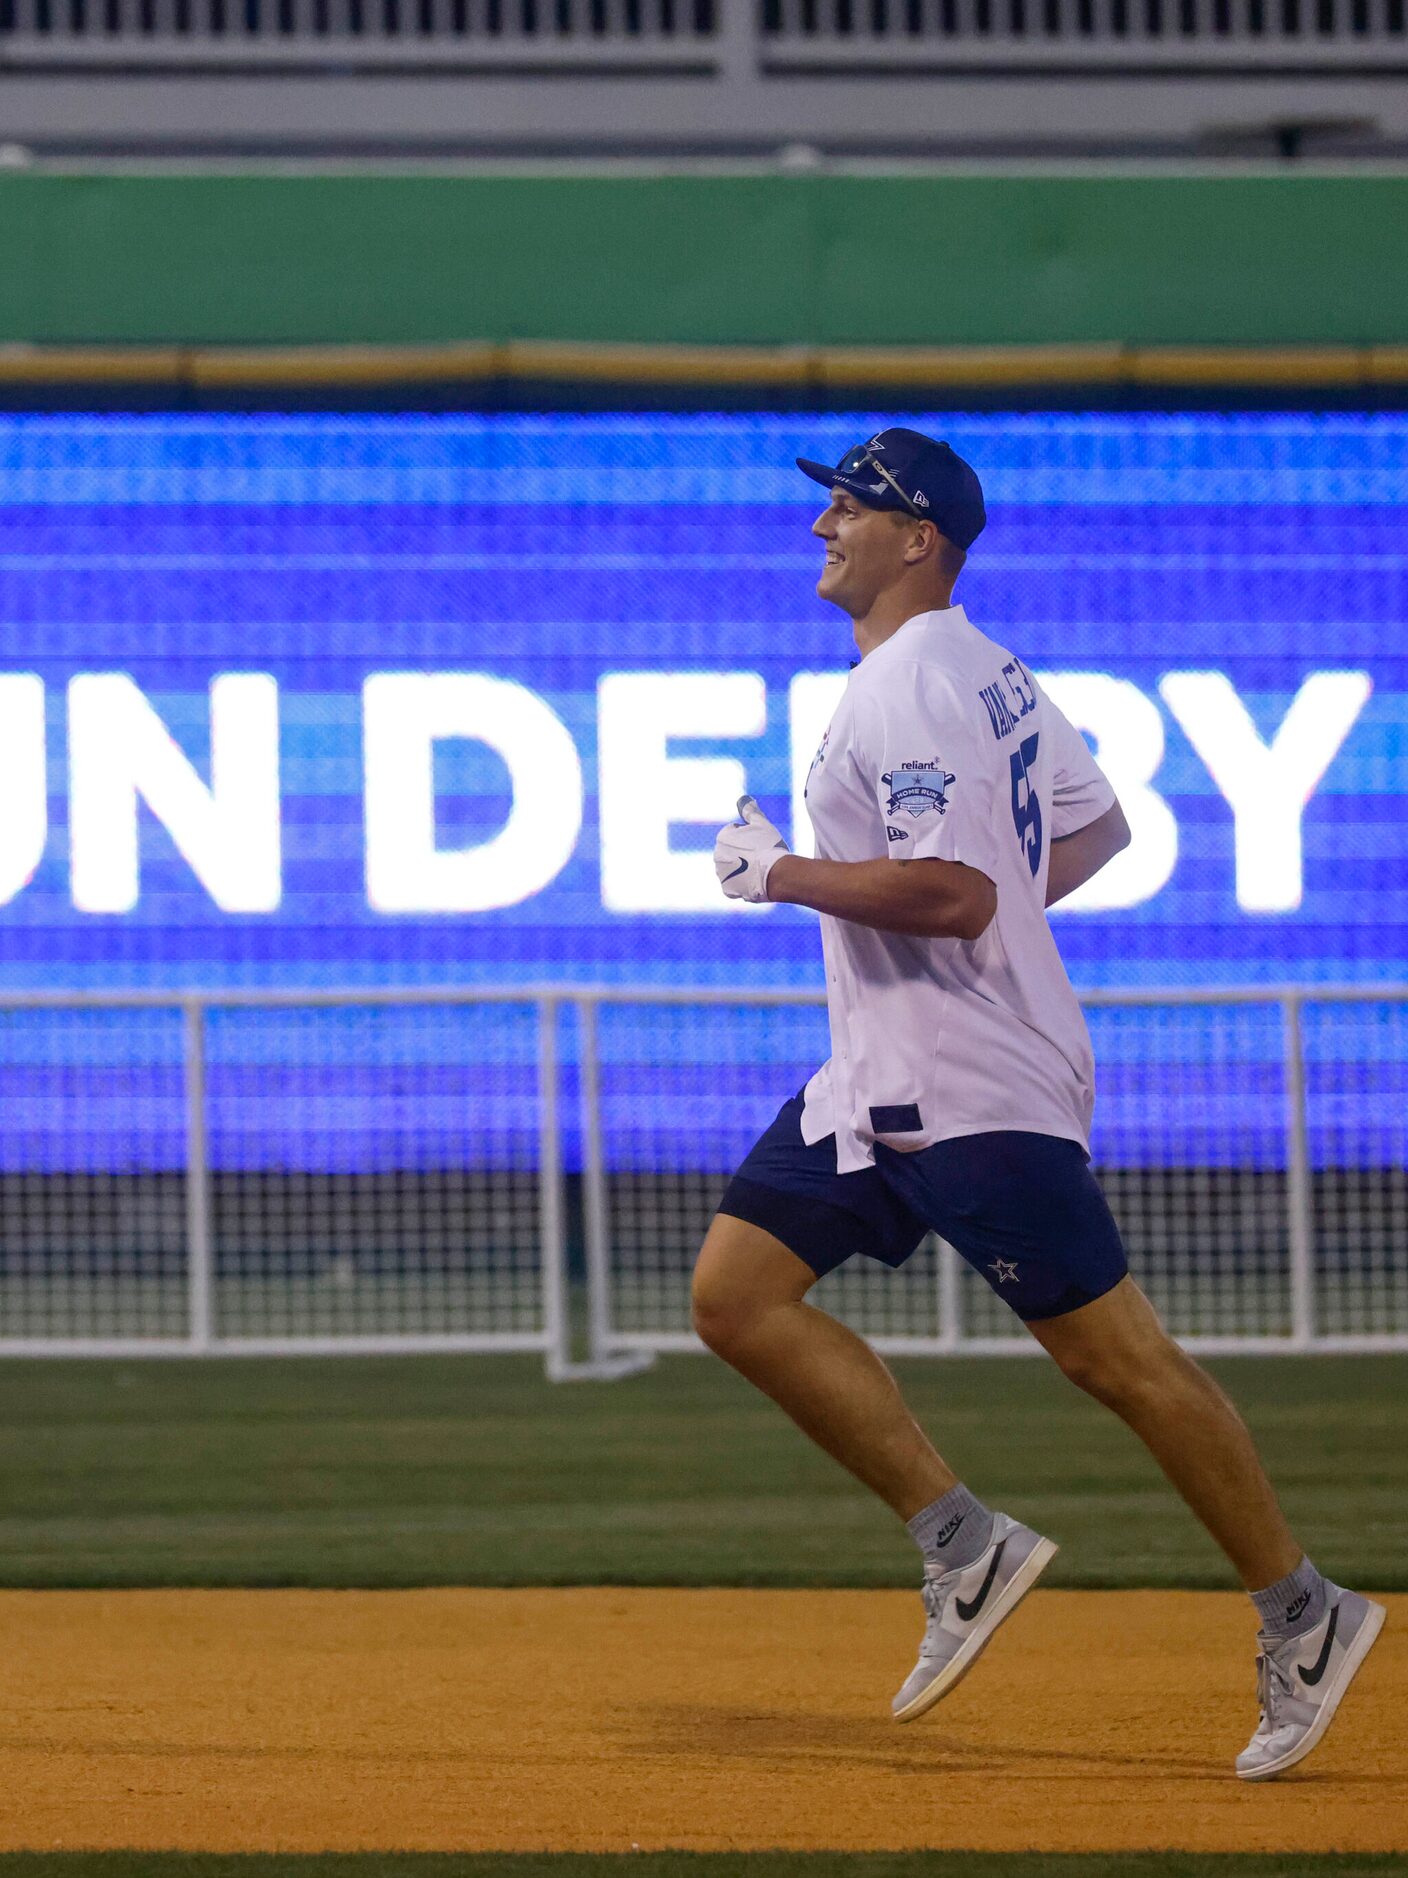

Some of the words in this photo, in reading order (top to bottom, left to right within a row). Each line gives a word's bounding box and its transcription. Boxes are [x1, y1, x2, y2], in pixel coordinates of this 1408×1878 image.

[363, 672, 1371, 915] DEY
[896, 788, 920, 799] HOME
[920, 788, 938, 799] RUN
